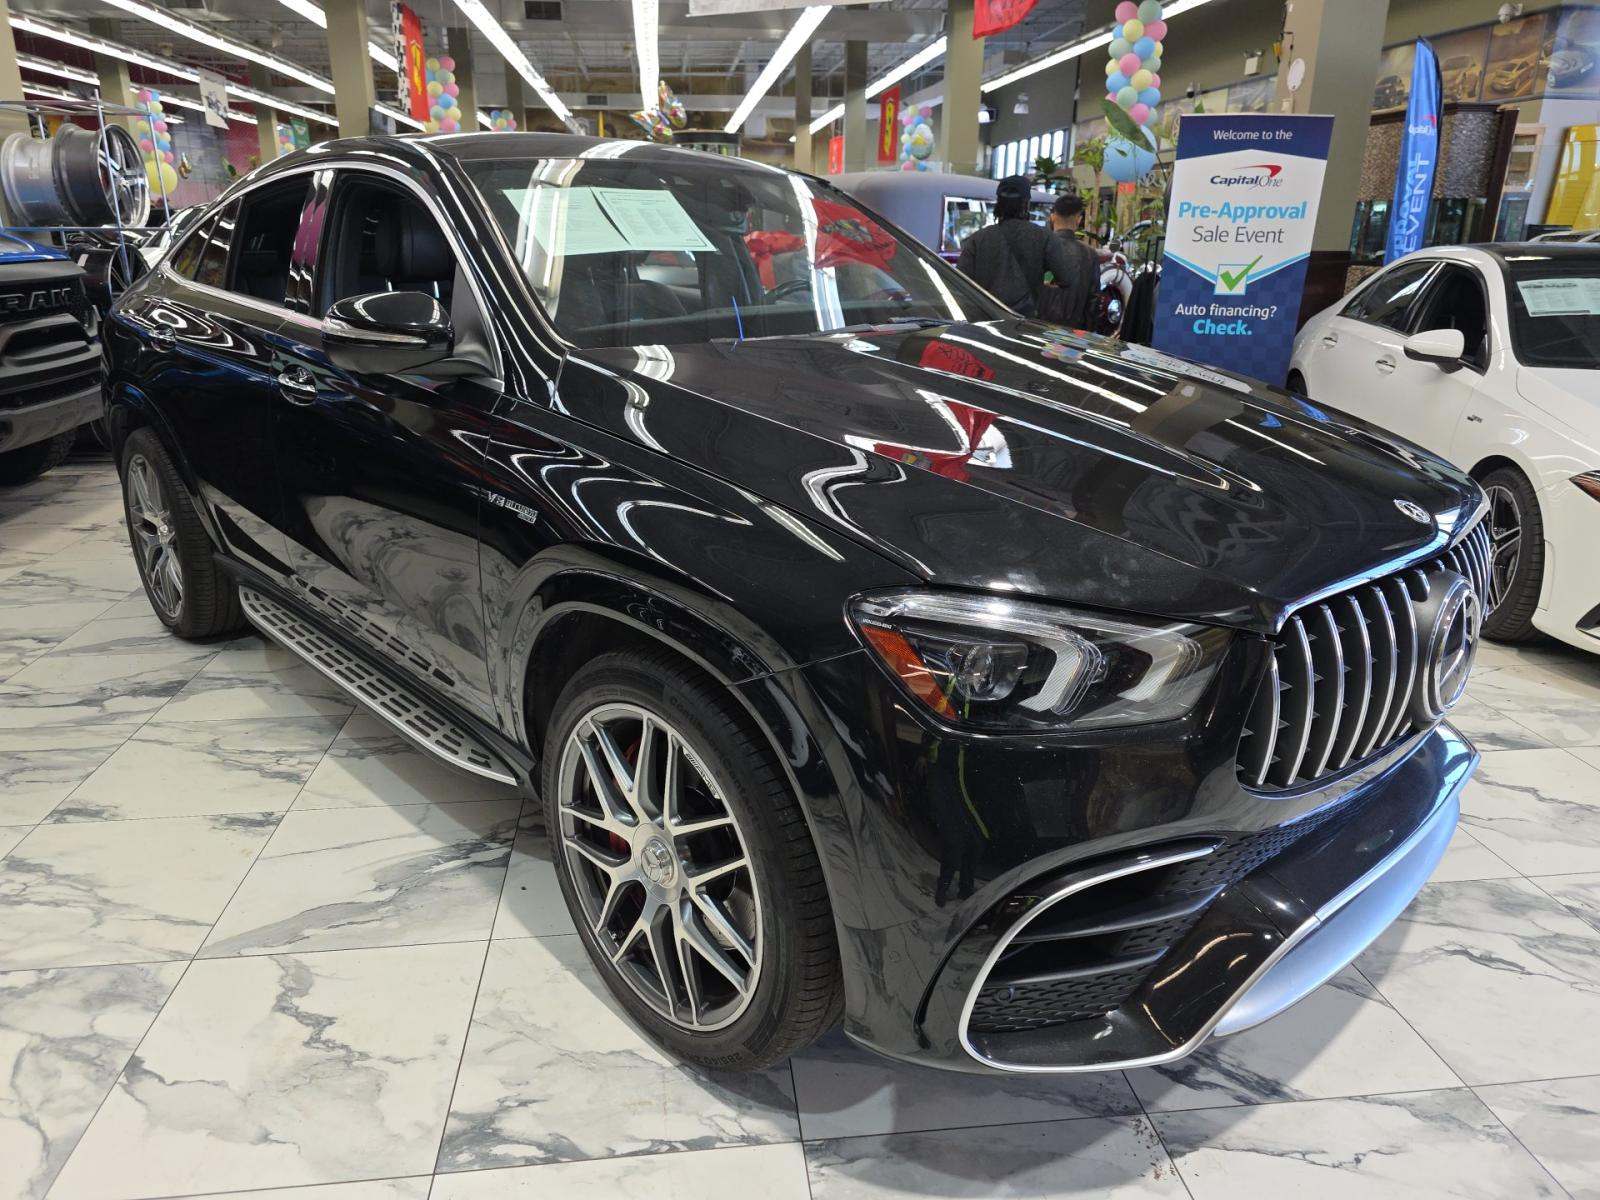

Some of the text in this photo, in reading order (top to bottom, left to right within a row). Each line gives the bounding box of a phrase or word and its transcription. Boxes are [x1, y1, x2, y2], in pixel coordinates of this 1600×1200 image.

[1213, 129, 1293, 140] Welcome to the
[1402, 152, 1431, 253] EVENT
[1178, 201, 1308, 224] Pre-Approval
[1191, 225, 1285, 243] Sale Event
[1174, 303, 1278, 321] Auto financing?
[1192, 319, 1253, 336] Check.
